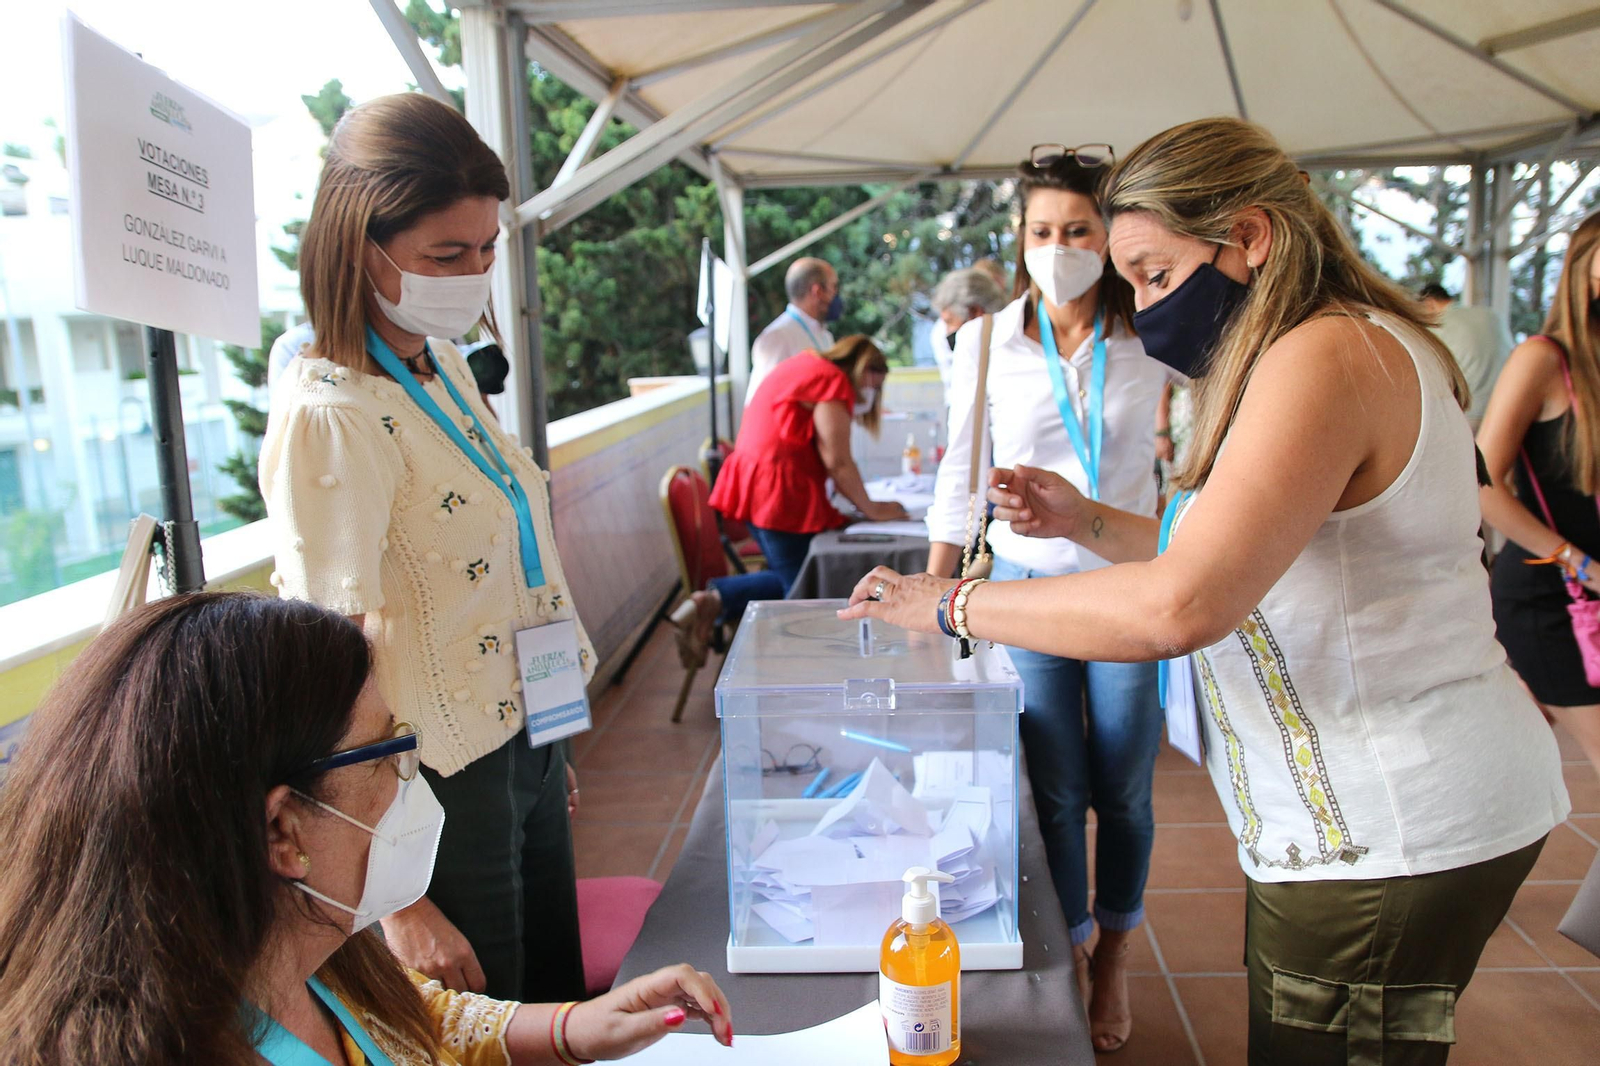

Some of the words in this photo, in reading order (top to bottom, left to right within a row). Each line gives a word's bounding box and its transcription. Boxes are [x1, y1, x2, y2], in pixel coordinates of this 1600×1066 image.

[138, 138, 209, 184] VOTACIONES
[148, 172, 179, 199] MESA
[198, 194, 205, 209] 3
[122, 243, 164, 271] LUQUE
[166, 256, 230, 291] MALDONADO
